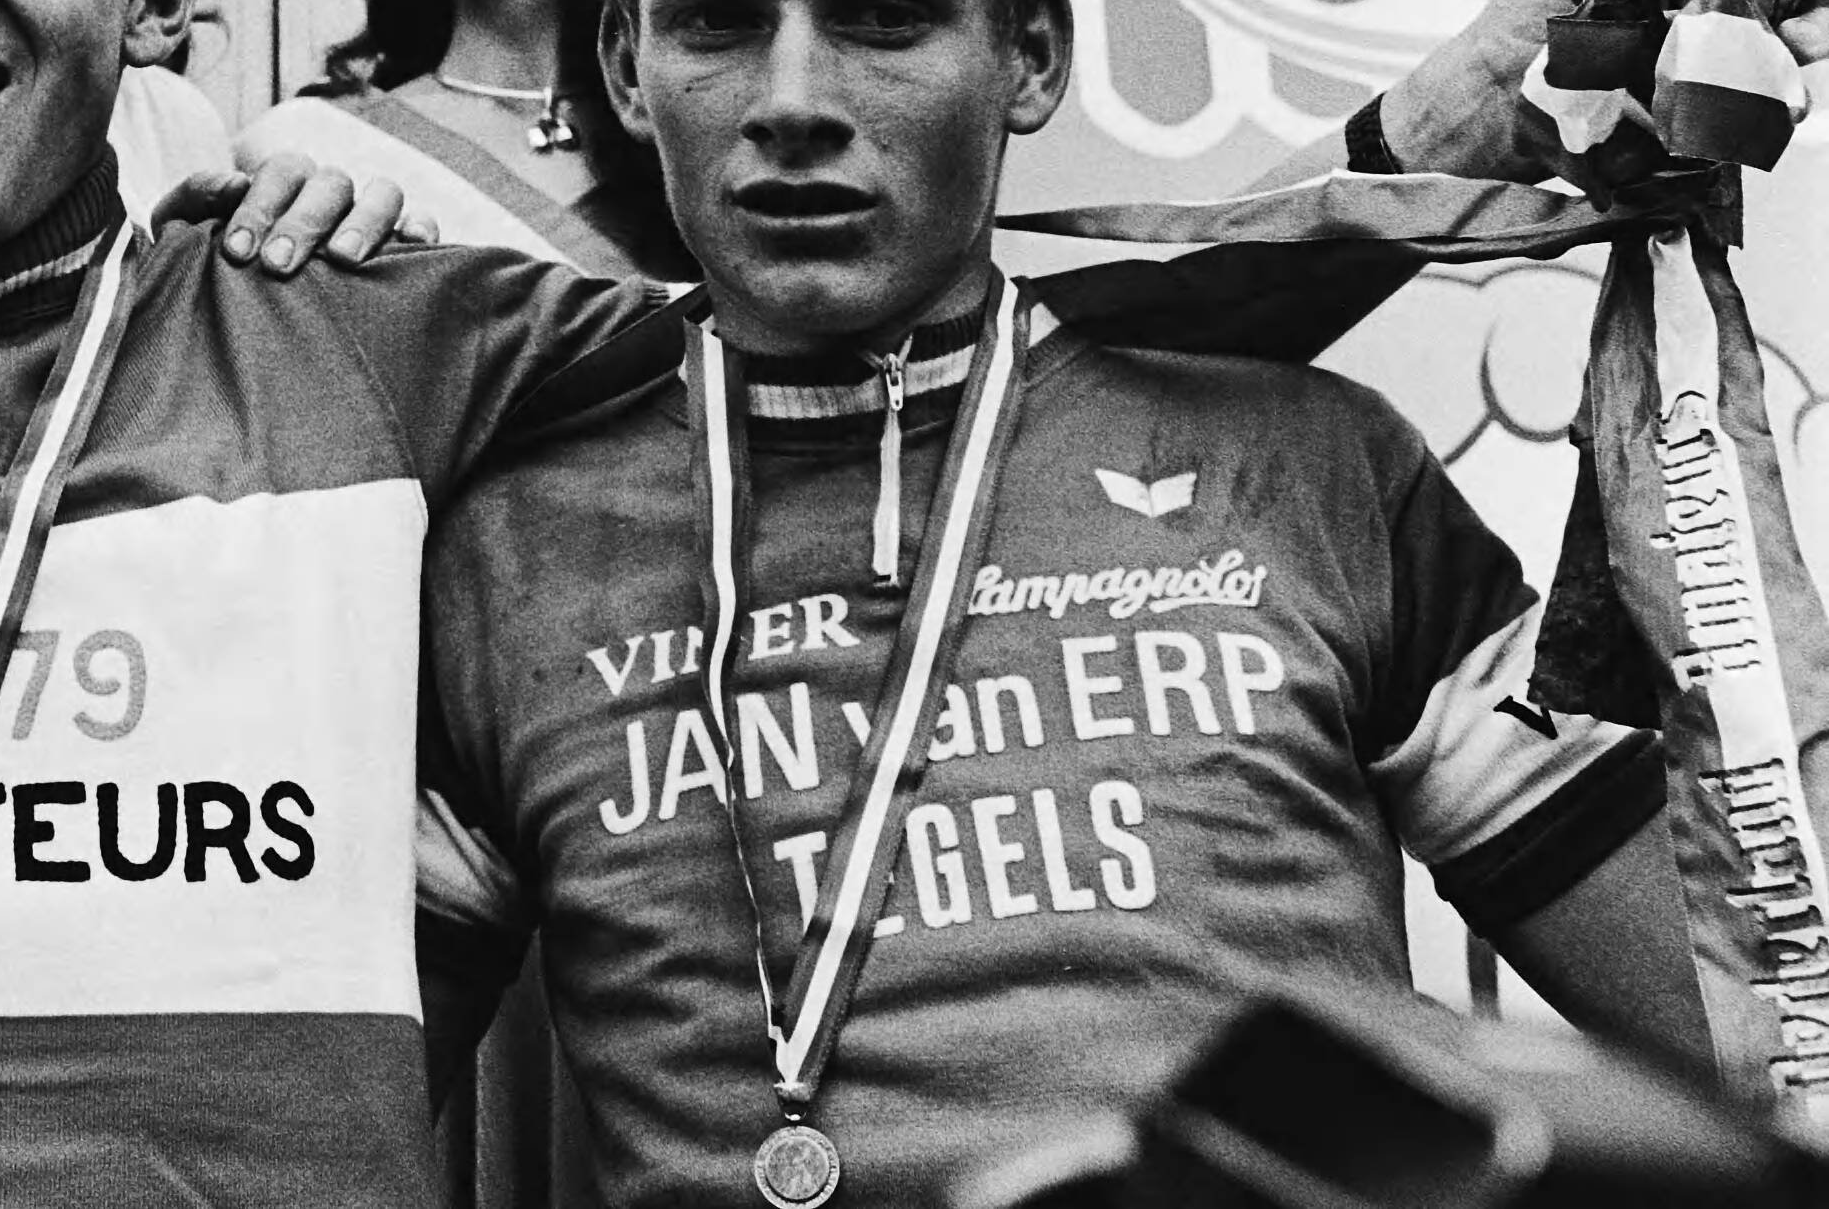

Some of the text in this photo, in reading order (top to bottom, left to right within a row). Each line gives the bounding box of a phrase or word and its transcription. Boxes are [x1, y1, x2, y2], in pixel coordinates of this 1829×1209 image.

[598, 681, 820, 835] JAN
[1062, 630, 1285, 741] ERP
[773, 779, 1157, 938] TGELS
